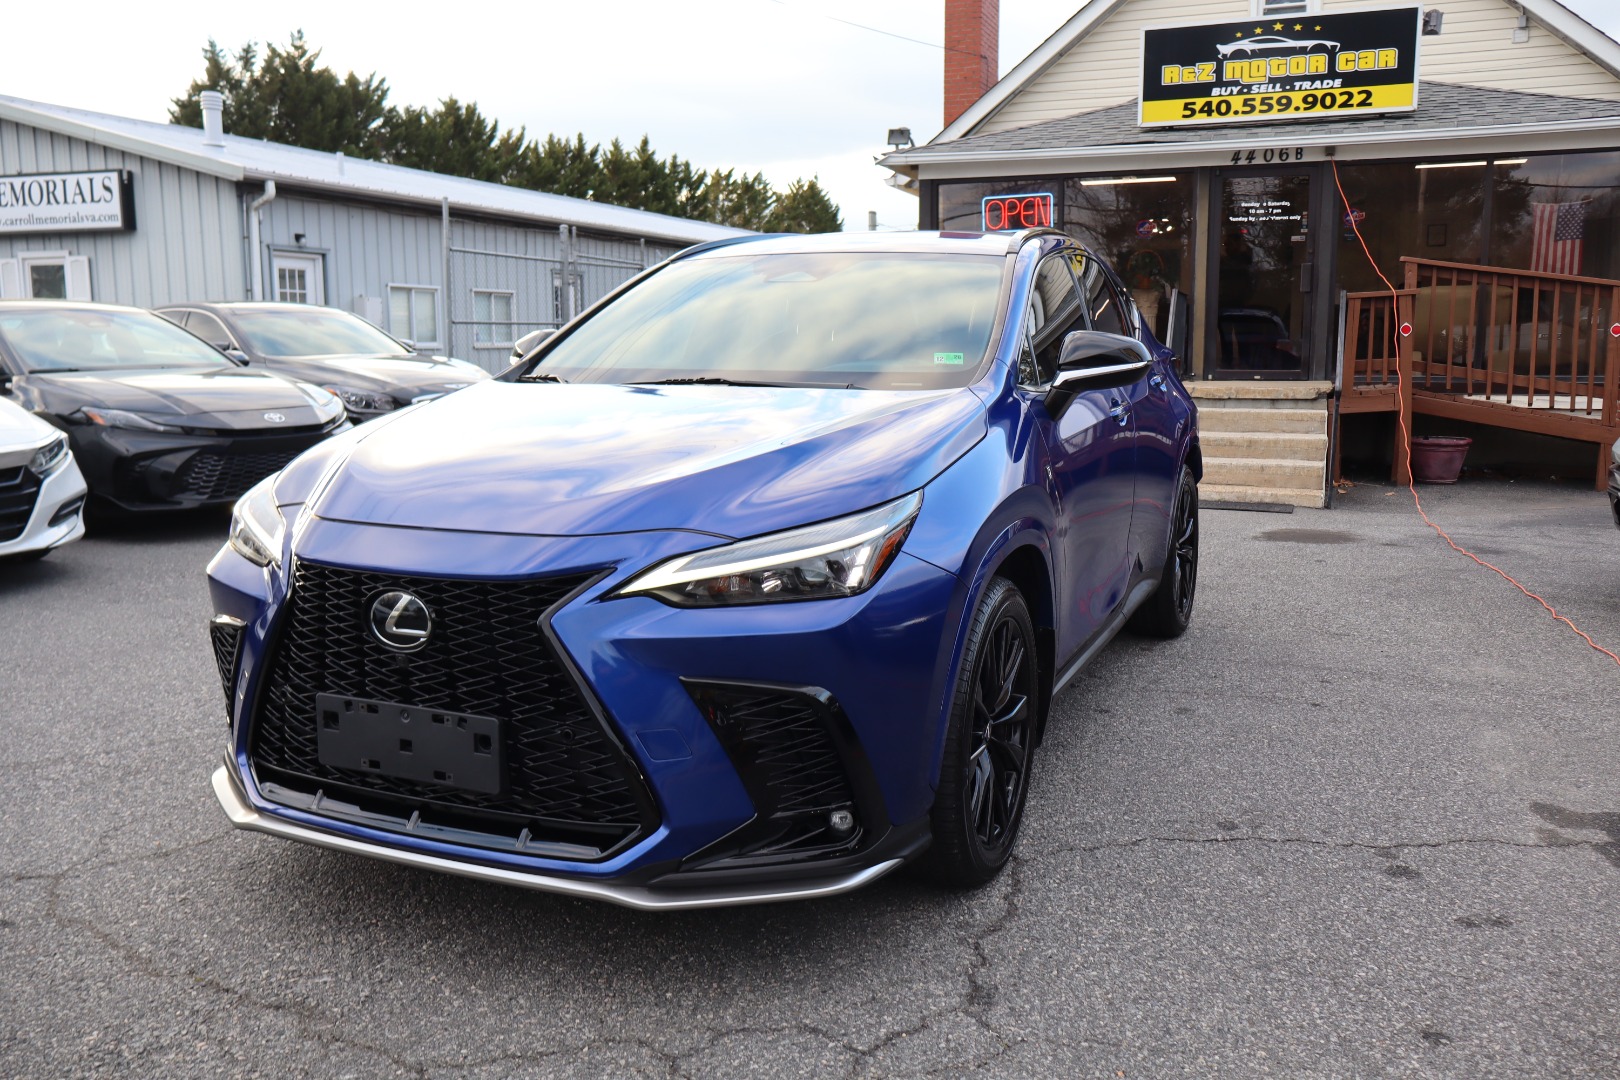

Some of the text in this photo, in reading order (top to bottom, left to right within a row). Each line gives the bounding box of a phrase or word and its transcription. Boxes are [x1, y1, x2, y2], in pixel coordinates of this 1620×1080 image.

[1162, 62, 1216, 86] R&Z
[1211, 79, 1343, 97] BUY SELL TRADE
[1182, 90, 1373, 118] 540.559.9022
[985, 196, 1050, 229] OPEN
